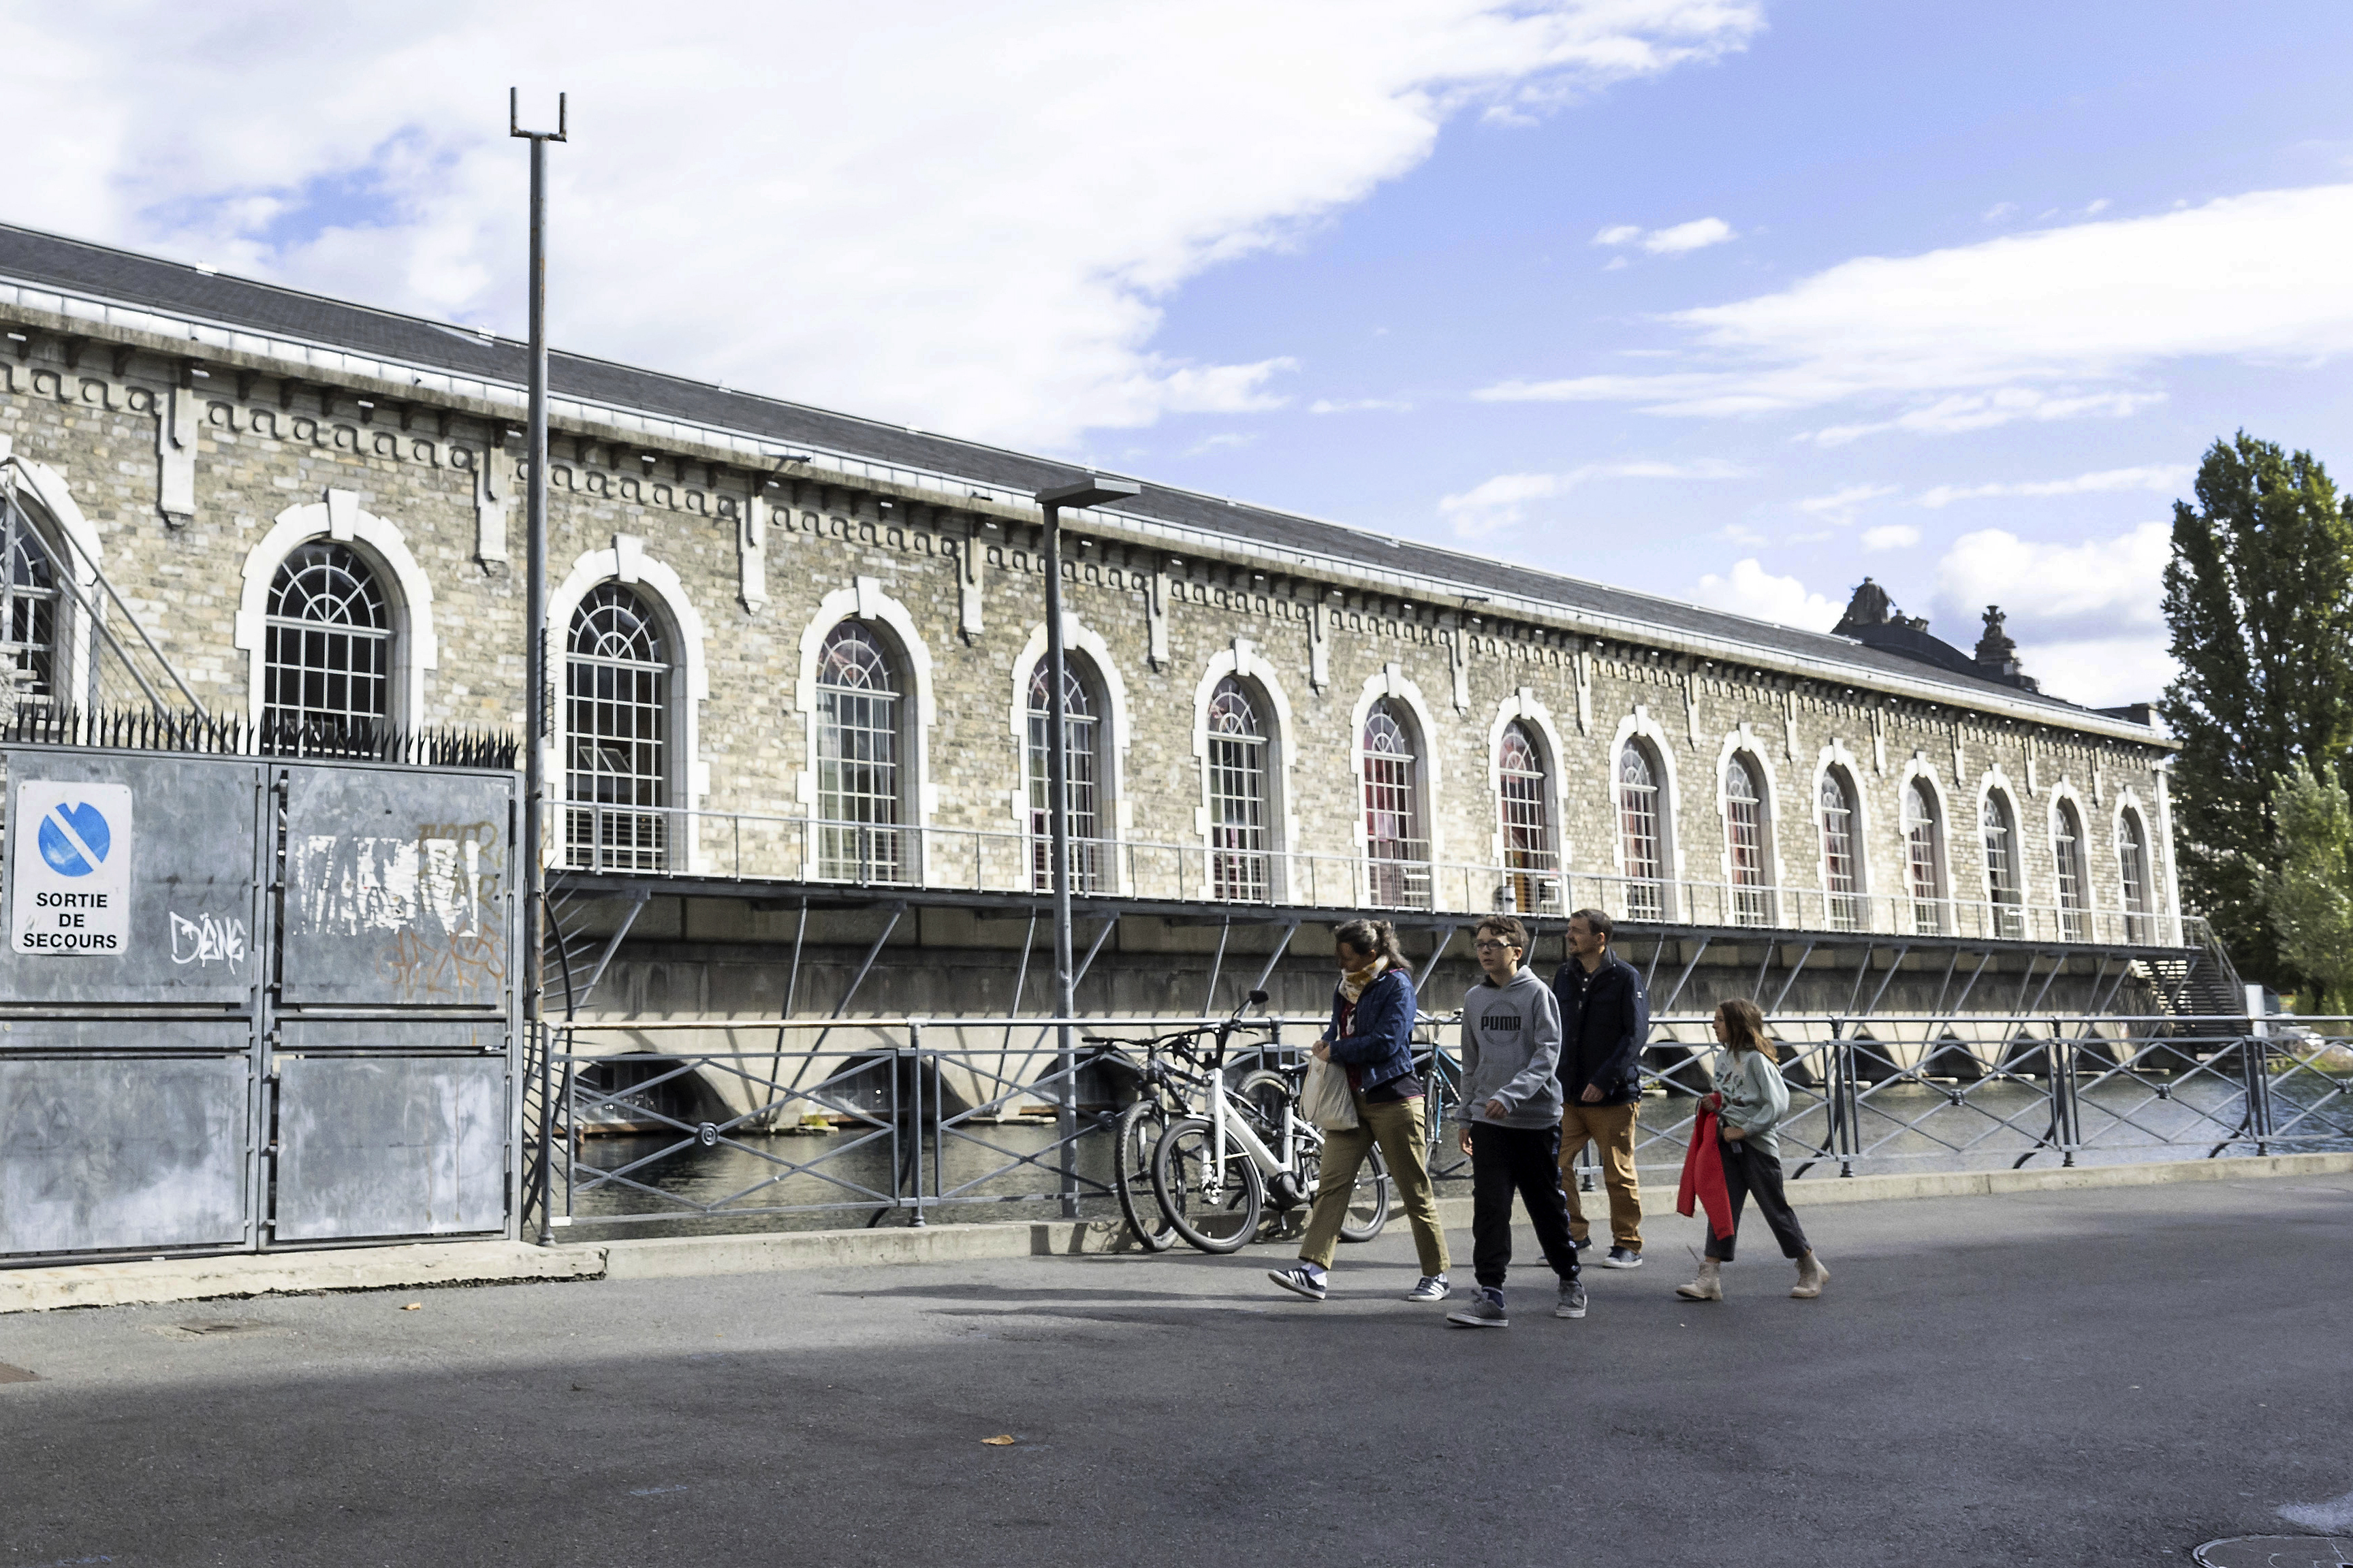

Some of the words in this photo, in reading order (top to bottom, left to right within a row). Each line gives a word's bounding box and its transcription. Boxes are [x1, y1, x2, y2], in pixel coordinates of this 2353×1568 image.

[36, 893, 107, 908] SORTIE
[59, 914, 84, 927] DE
[23, 933, 116, 948] SECOURS
[1481, 1016, 1521, 1031] PUMA
